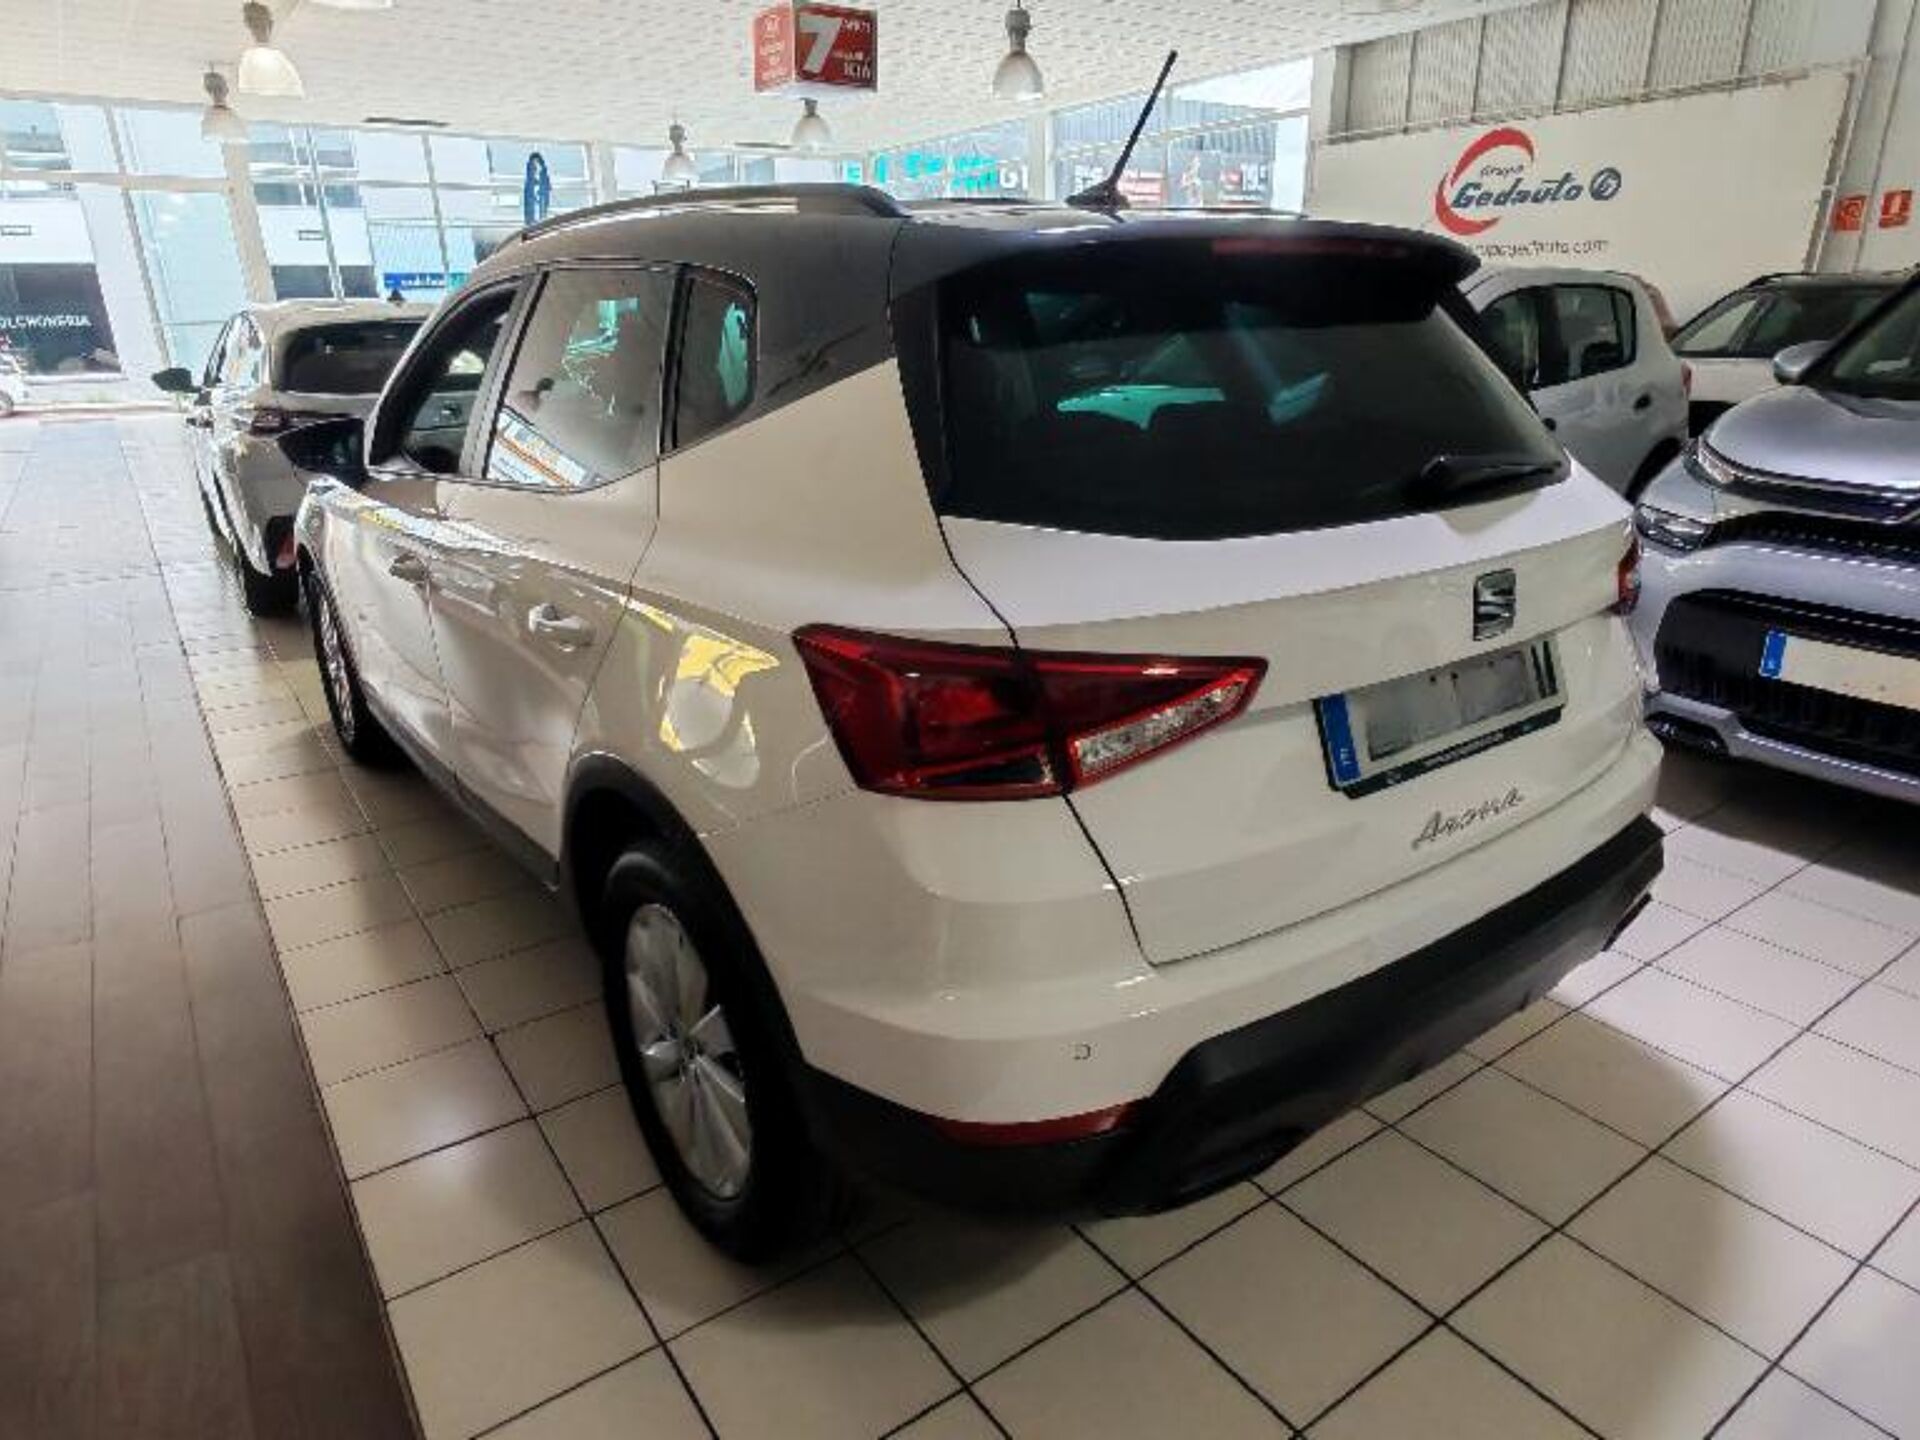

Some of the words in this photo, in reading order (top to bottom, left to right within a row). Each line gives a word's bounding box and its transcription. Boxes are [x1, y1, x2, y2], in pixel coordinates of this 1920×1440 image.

[798, 12, 842, 74] 7
[1450, 172, 1584, 208] Gedauto
[1411, 787, 1525, 851] Arona
